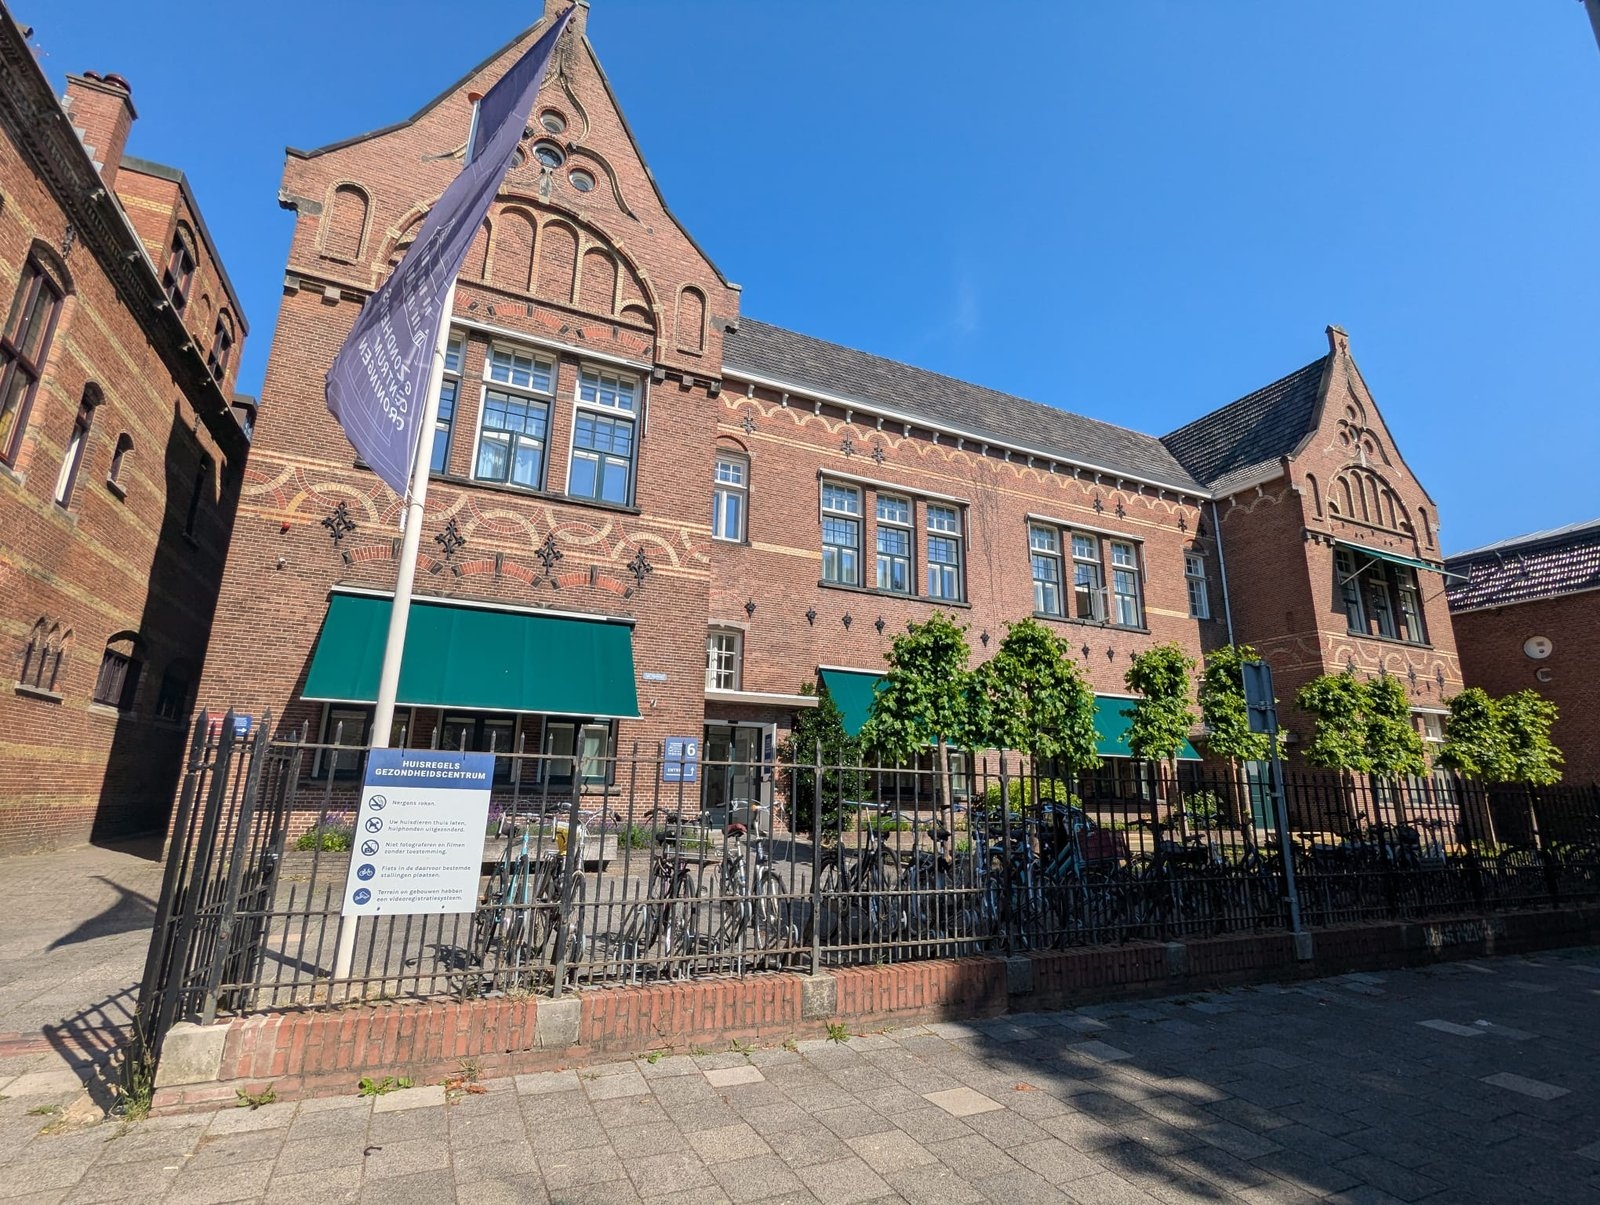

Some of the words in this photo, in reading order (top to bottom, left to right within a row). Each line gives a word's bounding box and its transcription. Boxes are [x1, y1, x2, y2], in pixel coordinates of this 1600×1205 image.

[687, 743, 696, 756] 6
[402, 760, 461, 770] HUISREGELS
[375, 768, 486, 780] GEZONDHEIDSCENTRUM
[406, 848, 448, 856] toestemming.
[389, 895, 463, 903] videoregistratiesysteem.
